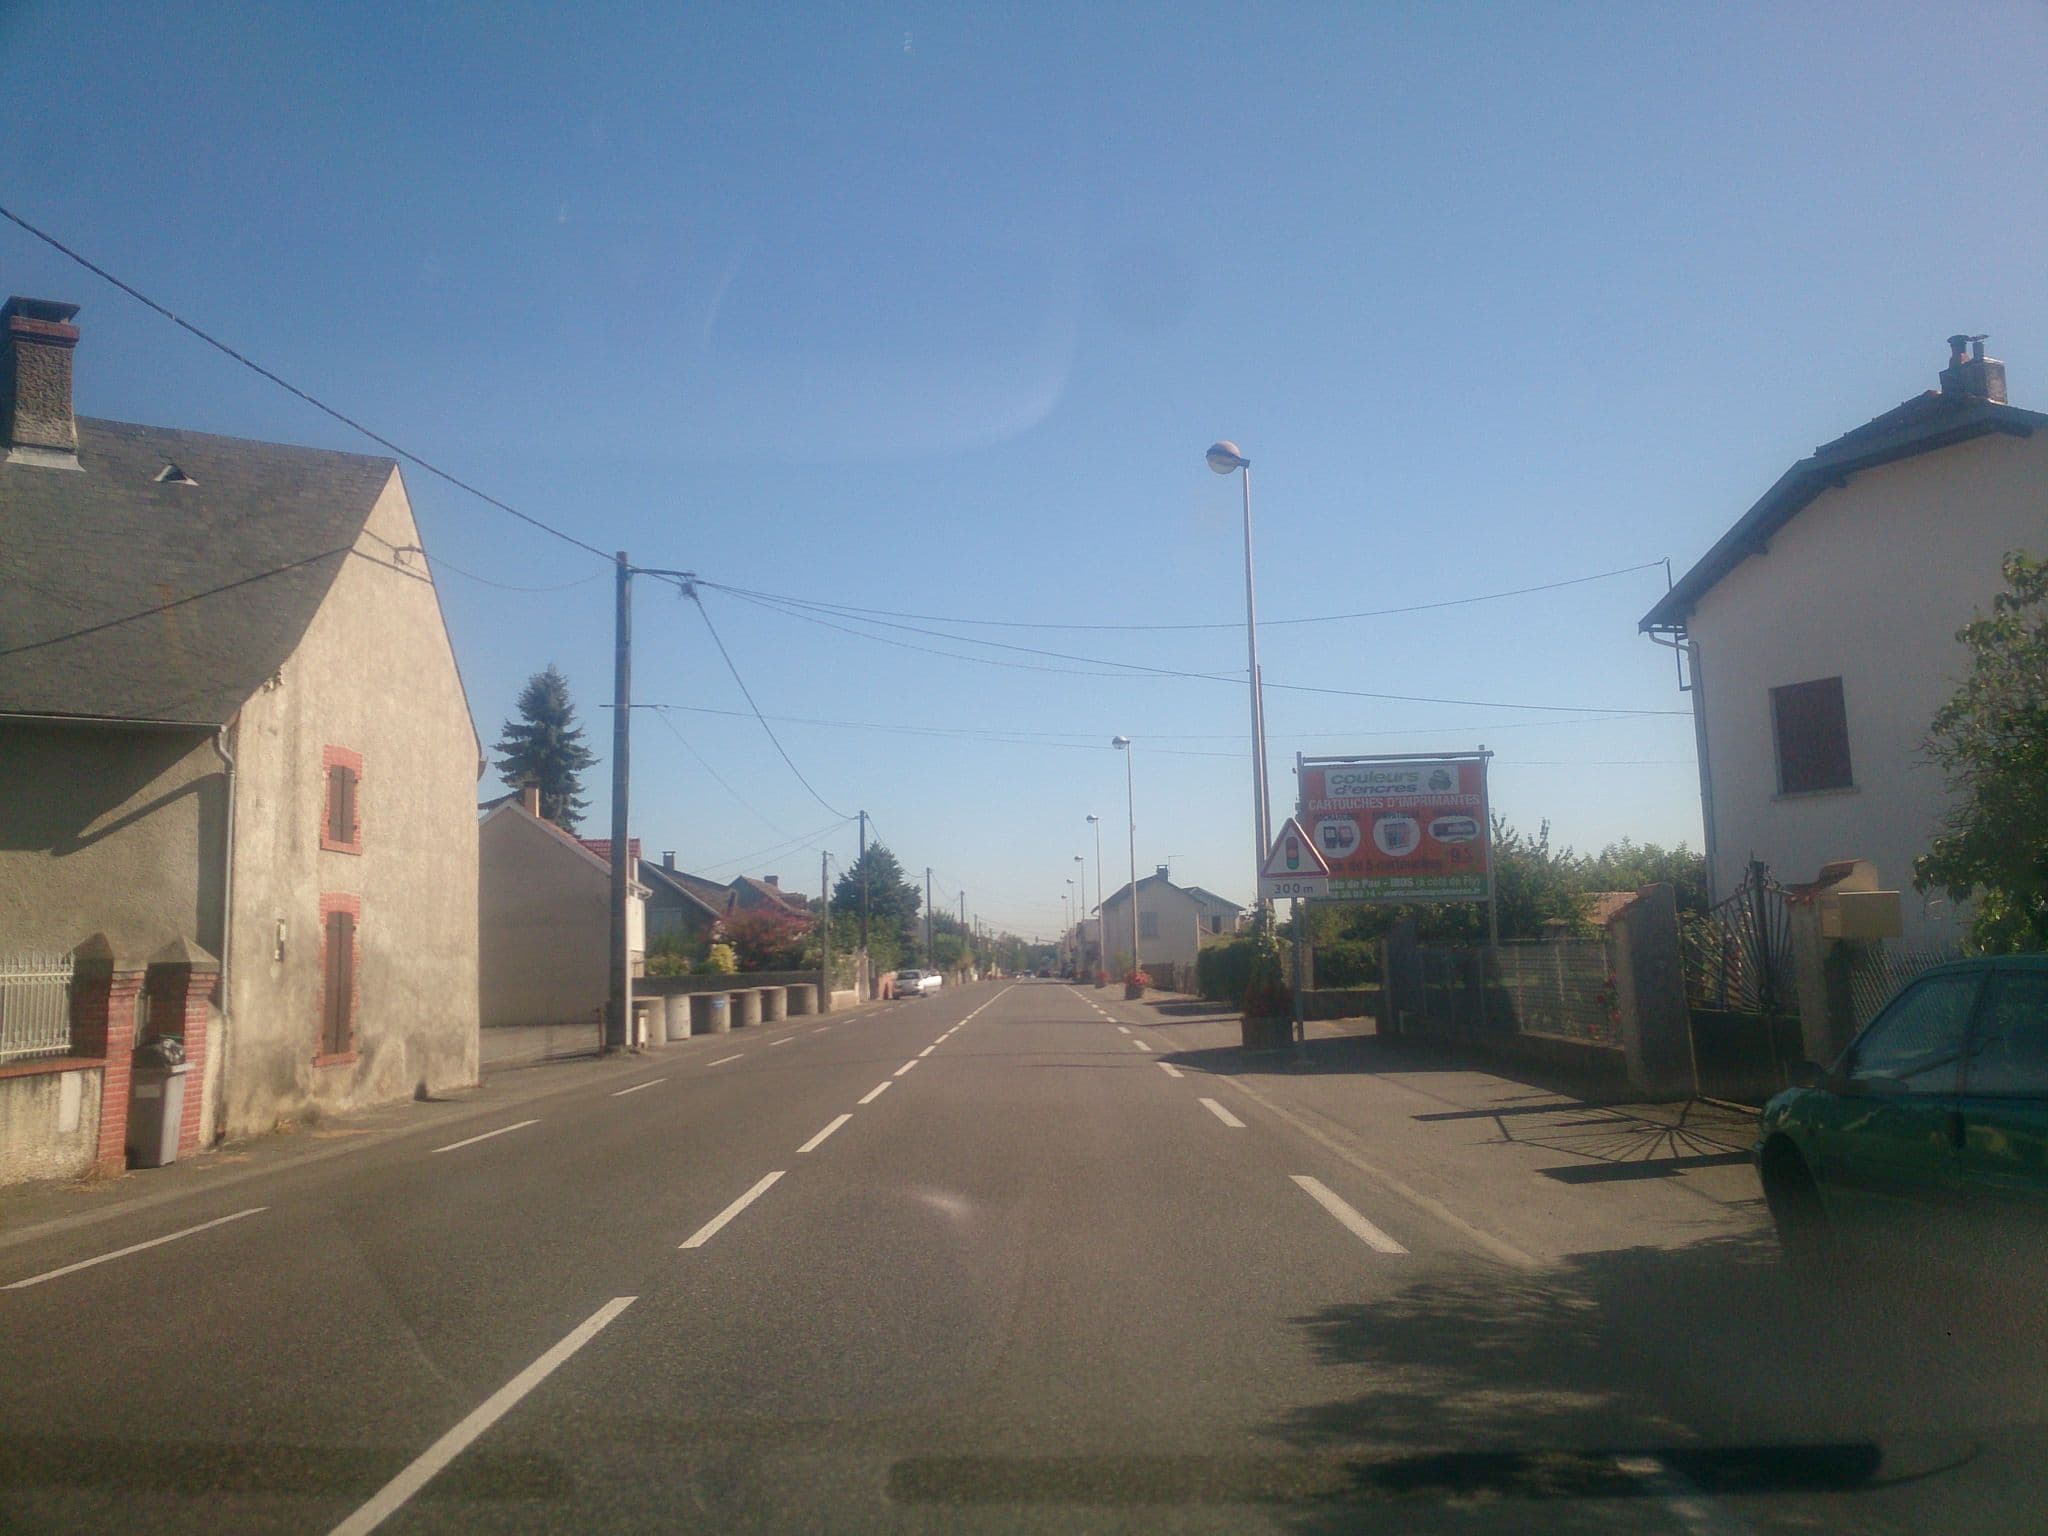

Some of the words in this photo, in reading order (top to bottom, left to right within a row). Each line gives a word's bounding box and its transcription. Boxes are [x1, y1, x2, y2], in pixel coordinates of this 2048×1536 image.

[1331, 769, 1419, 785] couleurs
[1334, 782, 1417, 795] d'encres
[1308, 797, 1383, 810] CARTOUCHES
[1274, 883, 1300, 894] 300
